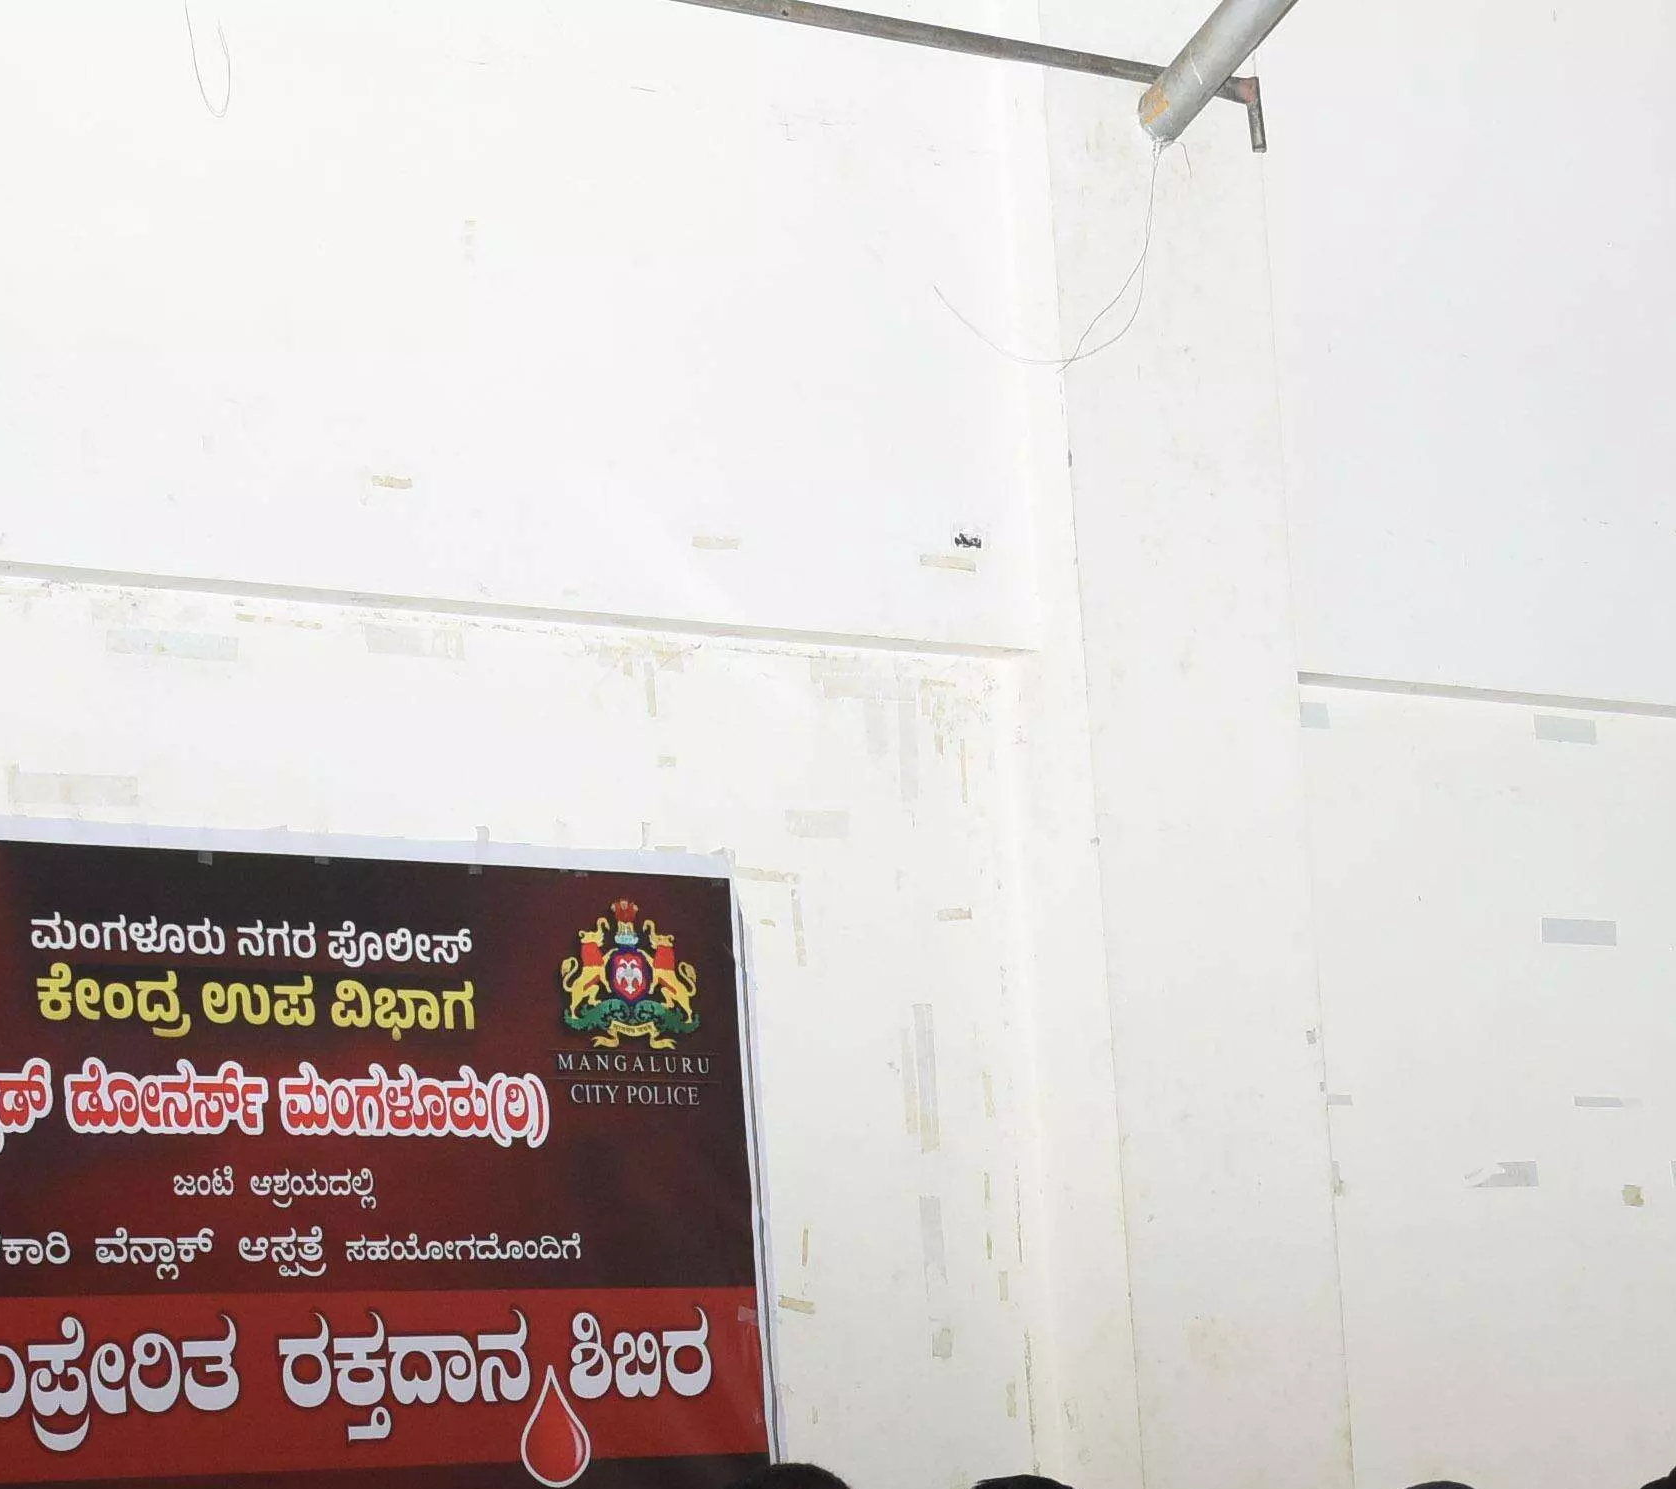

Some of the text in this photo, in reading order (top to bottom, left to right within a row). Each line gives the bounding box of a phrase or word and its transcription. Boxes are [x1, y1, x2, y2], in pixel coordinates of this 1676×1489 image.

[30, 911, 473, 969] ಮಂಗಳೂರು ನಗರ ಪೊಲೀಸ್
[36, 962, 476, 1042] ಕೇಂದ್ರ ಉಪ ವಿಭಾಗ
[557, 1053, 711, 1075] MANGALURU
[571, 1084, 701, 1106] CITY POLICE
[173, 1165, 377, 1209] ಜಂಟಿ ಆಶ್ರಯದಲ್ಲಿ
[94, 1226, 215, 1281] ವೆನ್ಲಾಕ್
[238, 1225, 327, 1277] ಆಸ್ಪತ್ರೆ
[345, 1230, 582, 1262] ಸಹಯೋಗದೊಂದಿಗೆ
[278, 1308, 531, 1443] ರಕ್ತದಾನ
[568, 1306, 713, 1400] ಶಿಬಿರ
